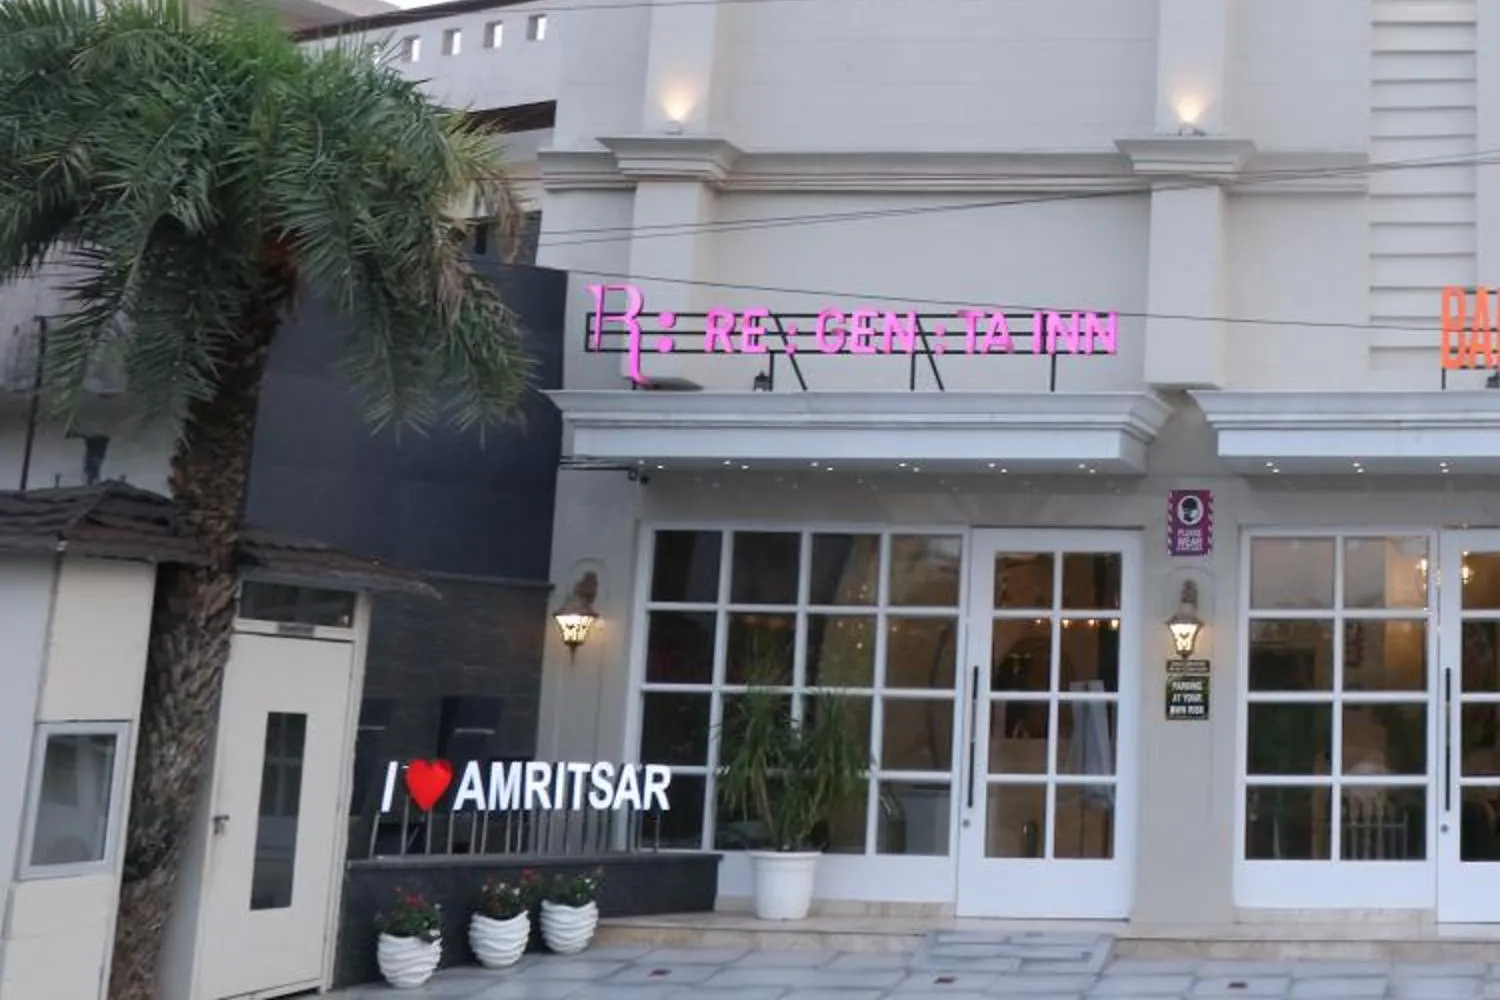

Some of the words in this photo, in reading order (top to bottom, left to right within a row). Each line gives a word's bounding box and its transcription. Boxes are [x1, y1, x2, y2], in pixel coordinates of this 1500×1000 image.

[1031, 310, 1118, 356] INN
[380, 760, 398, 812] I
[452, 760, 671, 811] AMRITSAR
